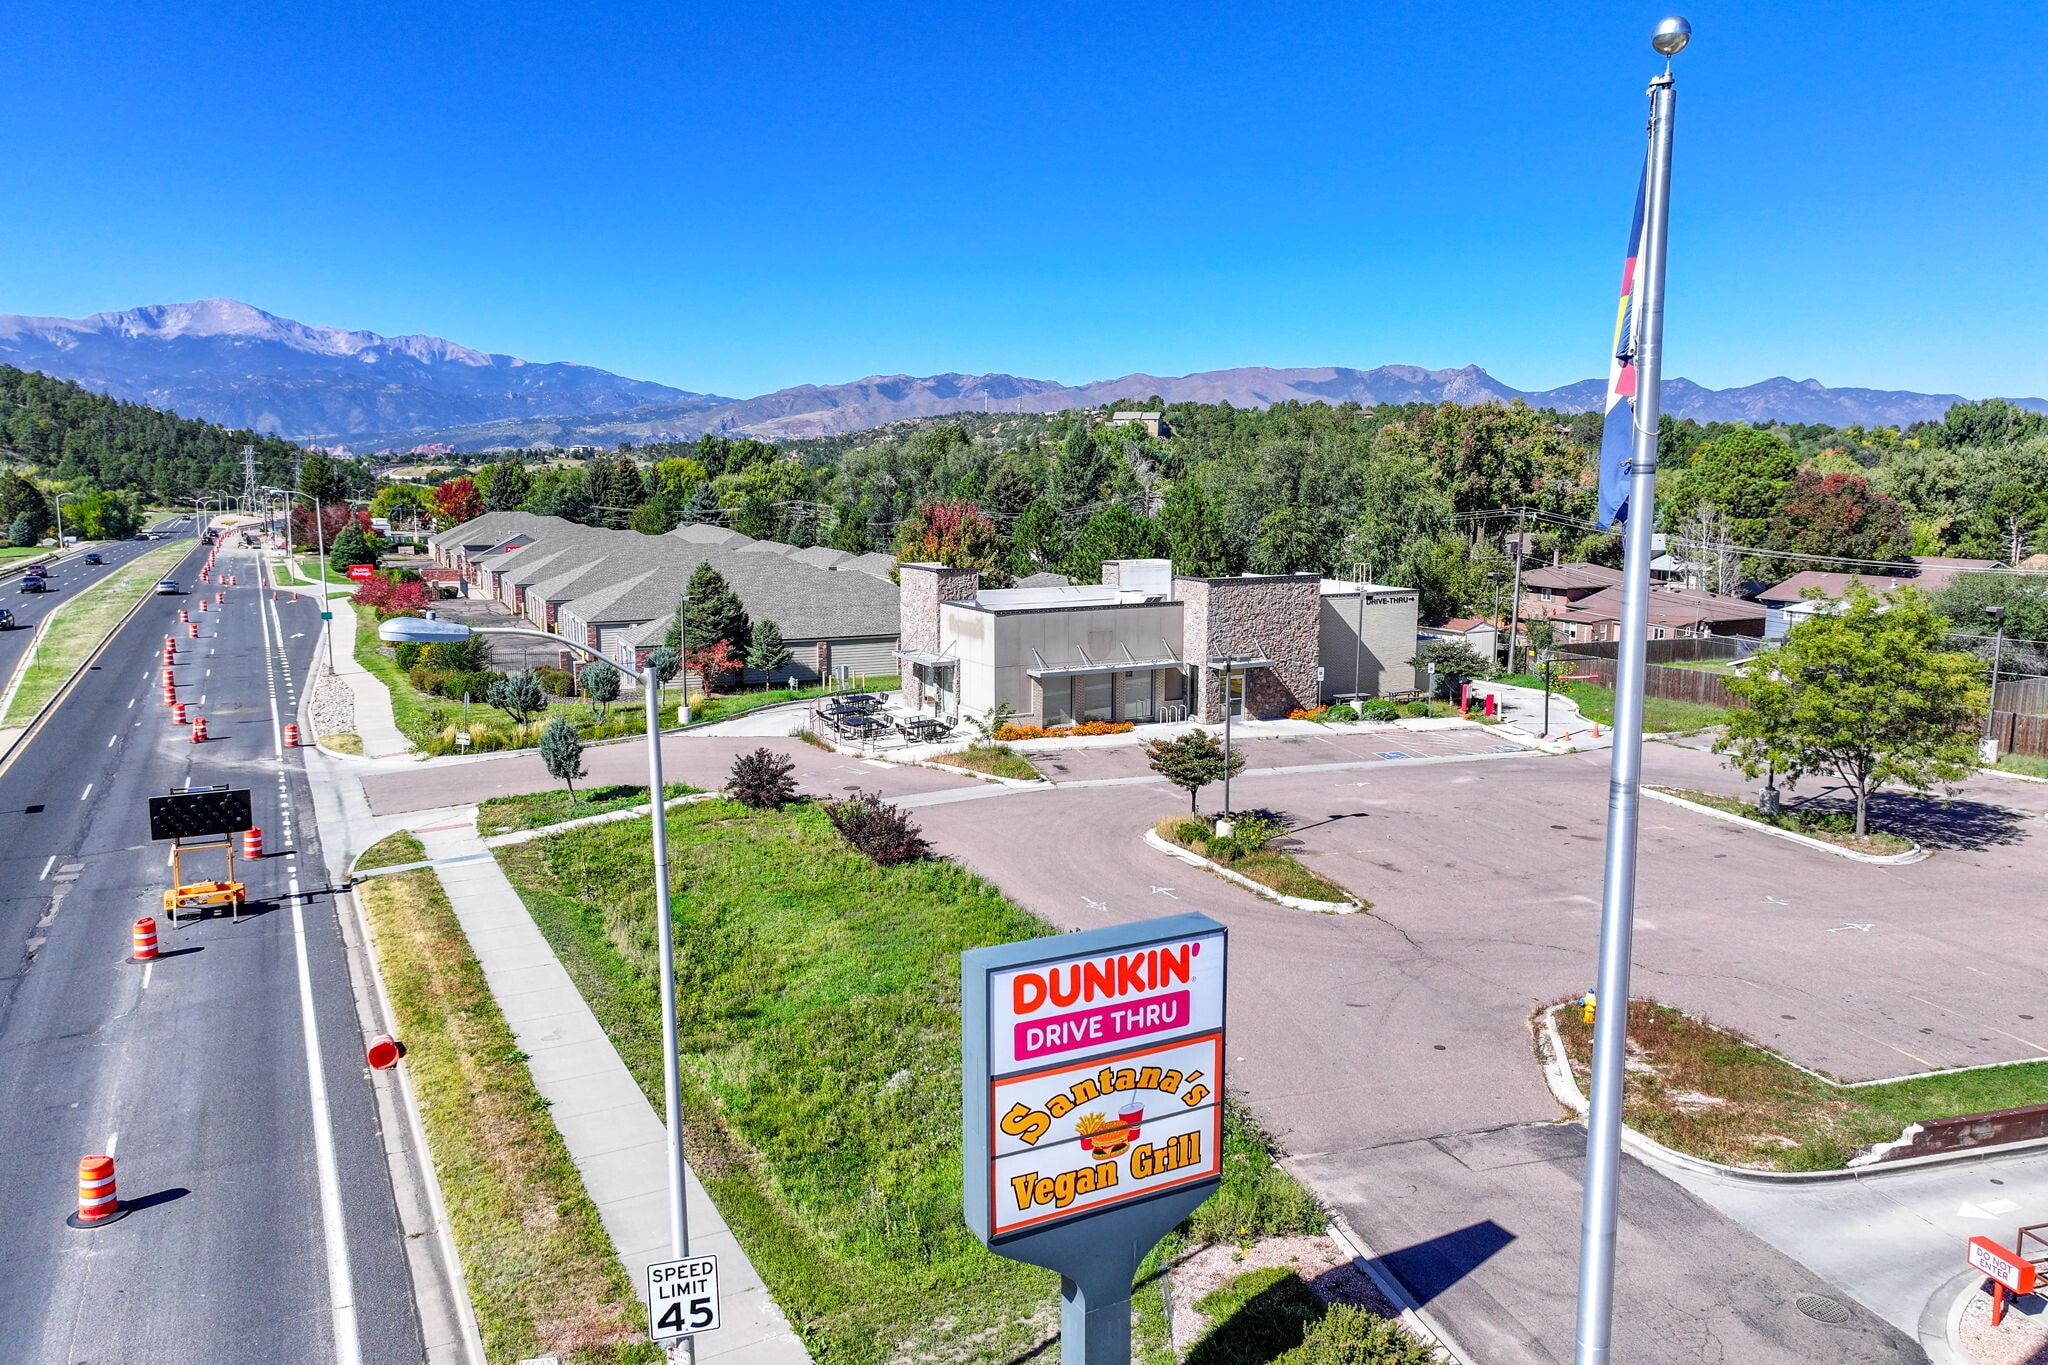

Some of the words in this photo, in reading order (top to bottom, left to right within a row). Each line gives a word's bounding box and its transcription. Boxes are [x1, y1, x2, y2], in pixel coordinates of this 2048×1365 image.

[1366, 597, 1408, 605] DRIVE-THRU
[1013, 942, 1200, 1015] DUNKIN'
[1026, 1021, 1102, 1052] DRIVE
[1111, 999, 1177, 1035] THRU
[1000, 1066, 1210, 1146] Santana's
[1011, 1160, 1118, 1211] Vegan
[1130, 1130, 1201, 1180] Grill
[653, 1262, 713, 1283] SPEED
[1976, 1247, 1991, 1261] DO
[1992, 1257, 2013, 1273] NOT
[1979, 1258, 2009, 1281] ENTER
[659, 1279, 708, 1299] LIMIT
[657, 1297, 714, 1332] 45
